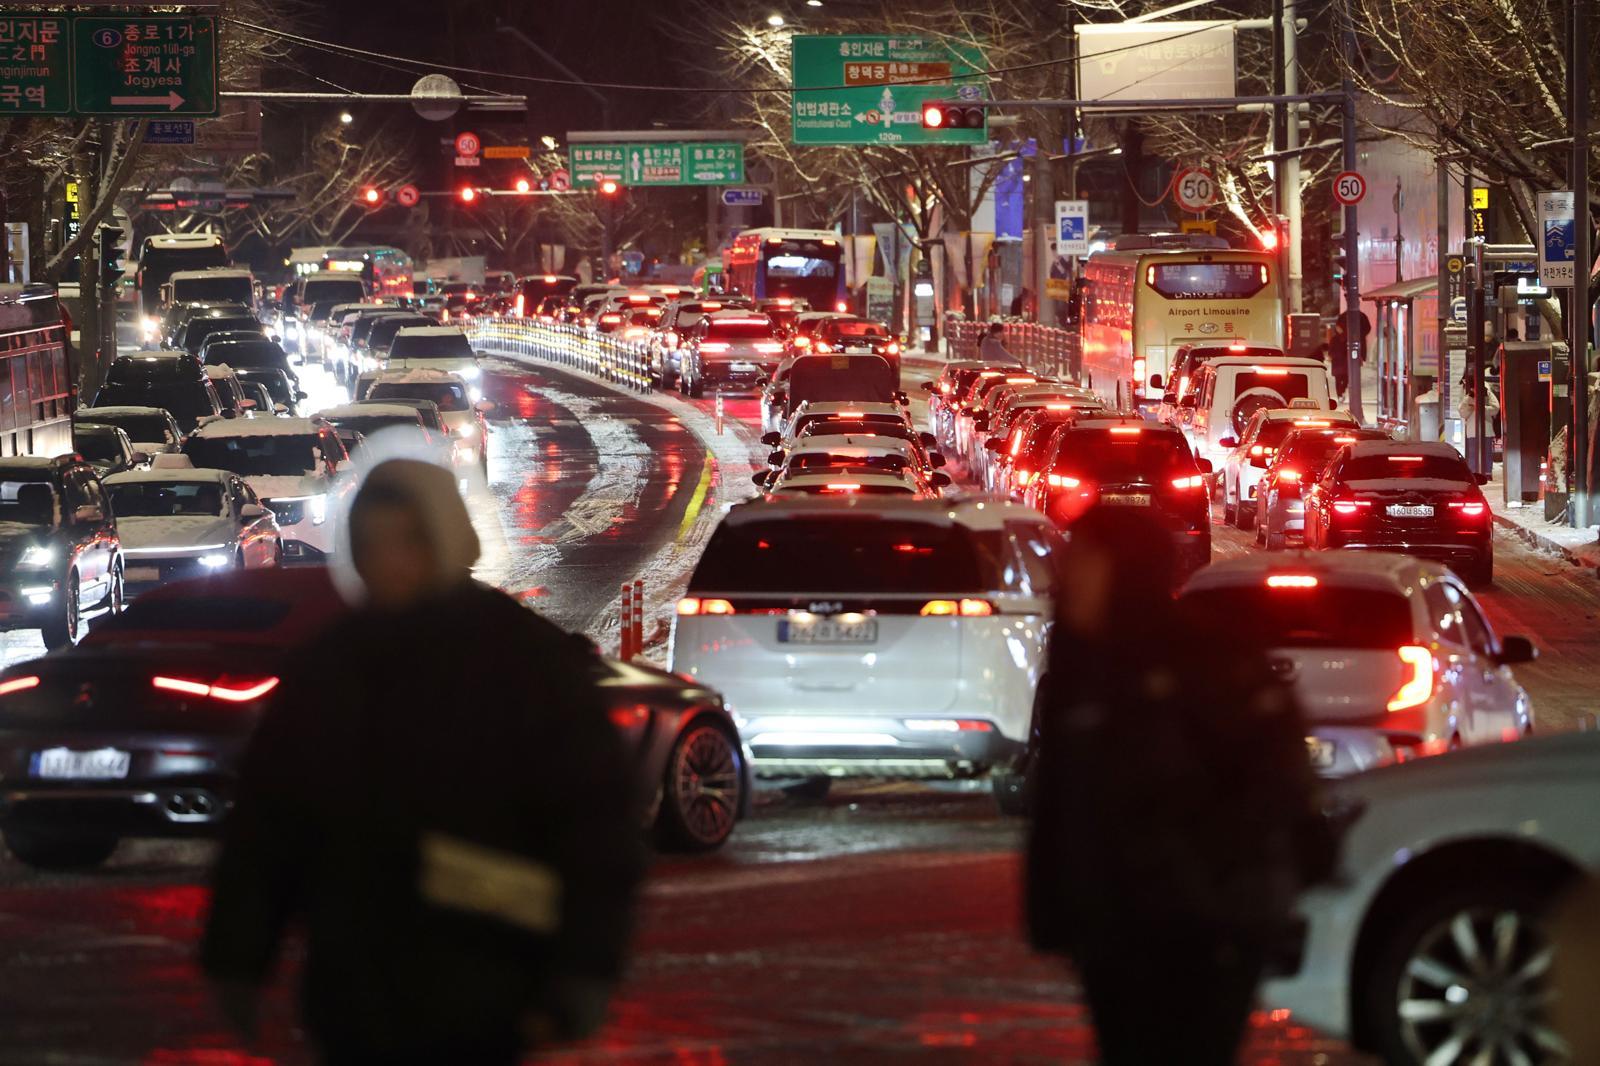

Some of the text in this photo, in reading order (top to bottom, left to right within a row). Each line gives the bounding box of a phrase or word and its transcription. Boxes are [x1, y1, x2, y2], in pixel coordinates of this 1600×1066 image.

[0, 21, 60, 43] 인지문
[102, 31, 113, 45] 6
[124, 43, 161, 57] Jongno
[839, 42, 885, 56] 흥인지문
[124, 56, 182, 74] 조계사
[848, 65, 885, 79] 창덕궁
[124, 74, 182, 88] Jogyesa
[0, 85, 45, 108] 국역
[796, 101, 852, 116] 헌법재판소
[878, 132, 902, 141] 120m
[1184, 179, 1209, 199] 50
[1340, 179, 1360, 197] 50
[1544, 199, 1574, 212] 율곡
[1168, 307, 1250, 316] Airport Limousine
[1184, 322, 1234, 333] 우 등
[1413, 507, 1433, 516] 8535
